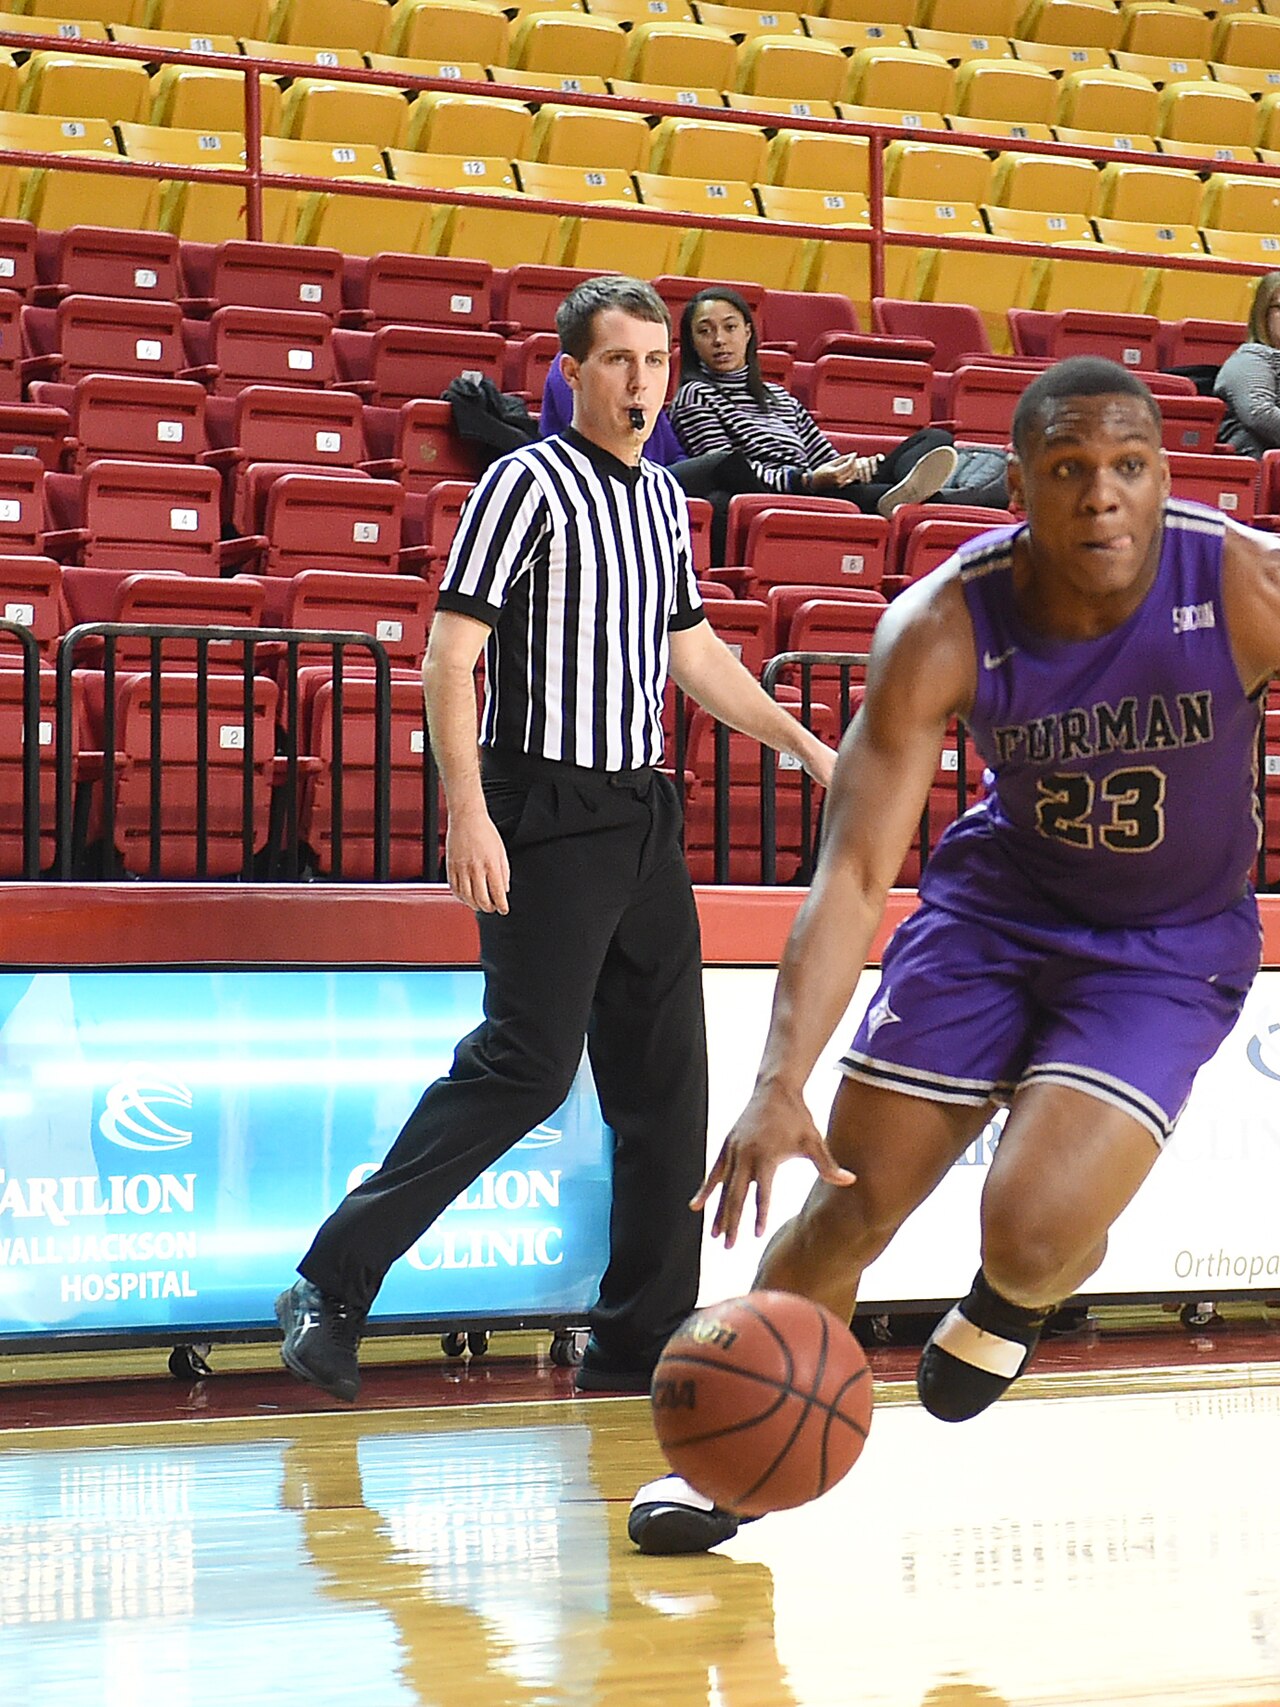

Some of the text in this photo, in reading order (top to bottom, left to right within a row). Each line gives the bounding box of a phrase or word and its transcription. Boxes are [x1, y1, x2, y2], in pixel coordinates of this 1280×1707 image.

[194, 39, 207, 51] 11
[319, 53, 333, 65] 12
[202, 136, 216, 148] 10
[338, 150, 350, 161] 11
[467, 163, 480, 174] 12
[588, 174, 602, 185] 13
[709, 186, 723, 196] 14
[827, 197, 840, 208] 15
[167, 425, 174, 438] 5
[325, 436, 333, 448] 6
[15, 608, 24, 623] 2
[385, 625, 393, 637] 4
[993, 690, 1213, 762] FURMAN
[230, 730, 239, 745] 2
[949, 754, 957, 767] 6
[1035, 765, 1167, 854] 23
[66, 1231, 197, 1264] JACKSON
[60, 1270, 198, 1303] HOSPITAL
